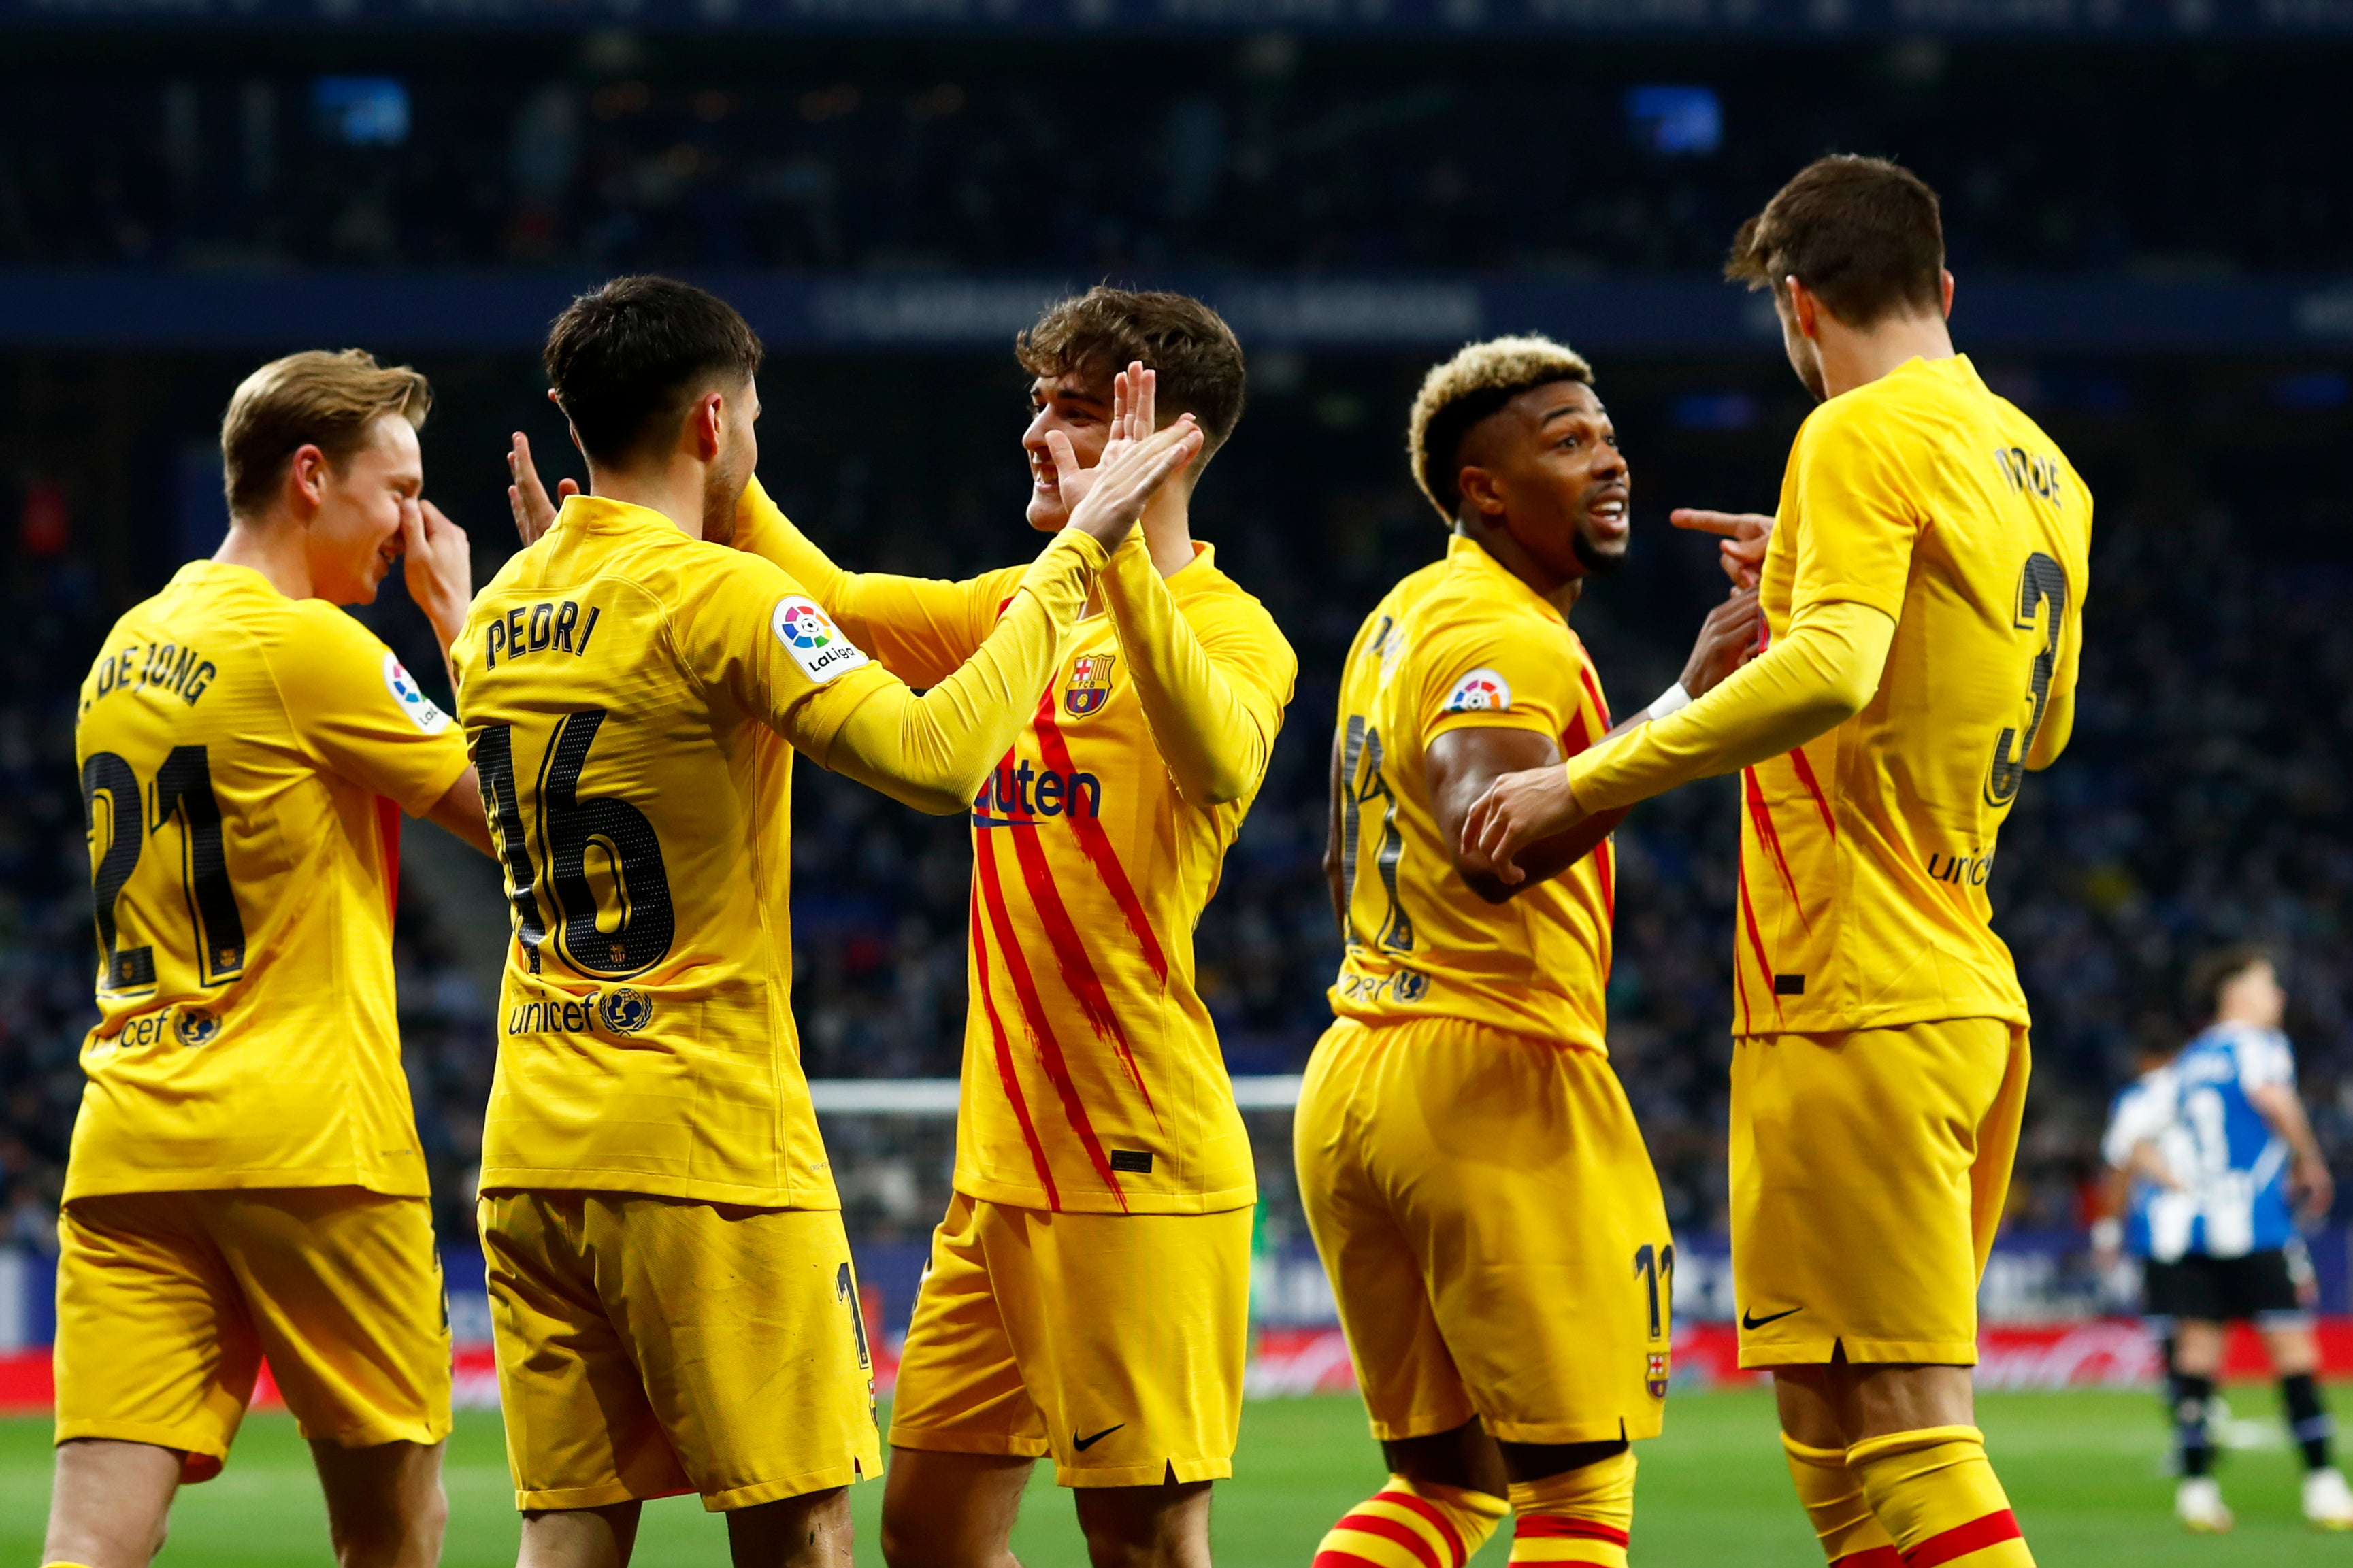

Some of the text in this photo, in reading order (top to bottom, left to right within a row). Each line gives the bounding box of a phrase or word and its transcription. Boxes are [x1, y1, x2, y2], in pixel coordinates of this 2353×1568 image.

[486, 601, 601, 671] PEDRI
[808, 647, 855, 672] LaLiga
[97, 646, 139, 701] DE
[133, 642, 216, 707] JONG
[1077, 680, 1096, 689] FCB
[1984, 552, 2067, 807] 3
[418, 707, 438, 725] LaL
[82, 745, 246, 999] 21
[474, 709, 675, 983] 16
[508, 990, 599, 1036] unicef
